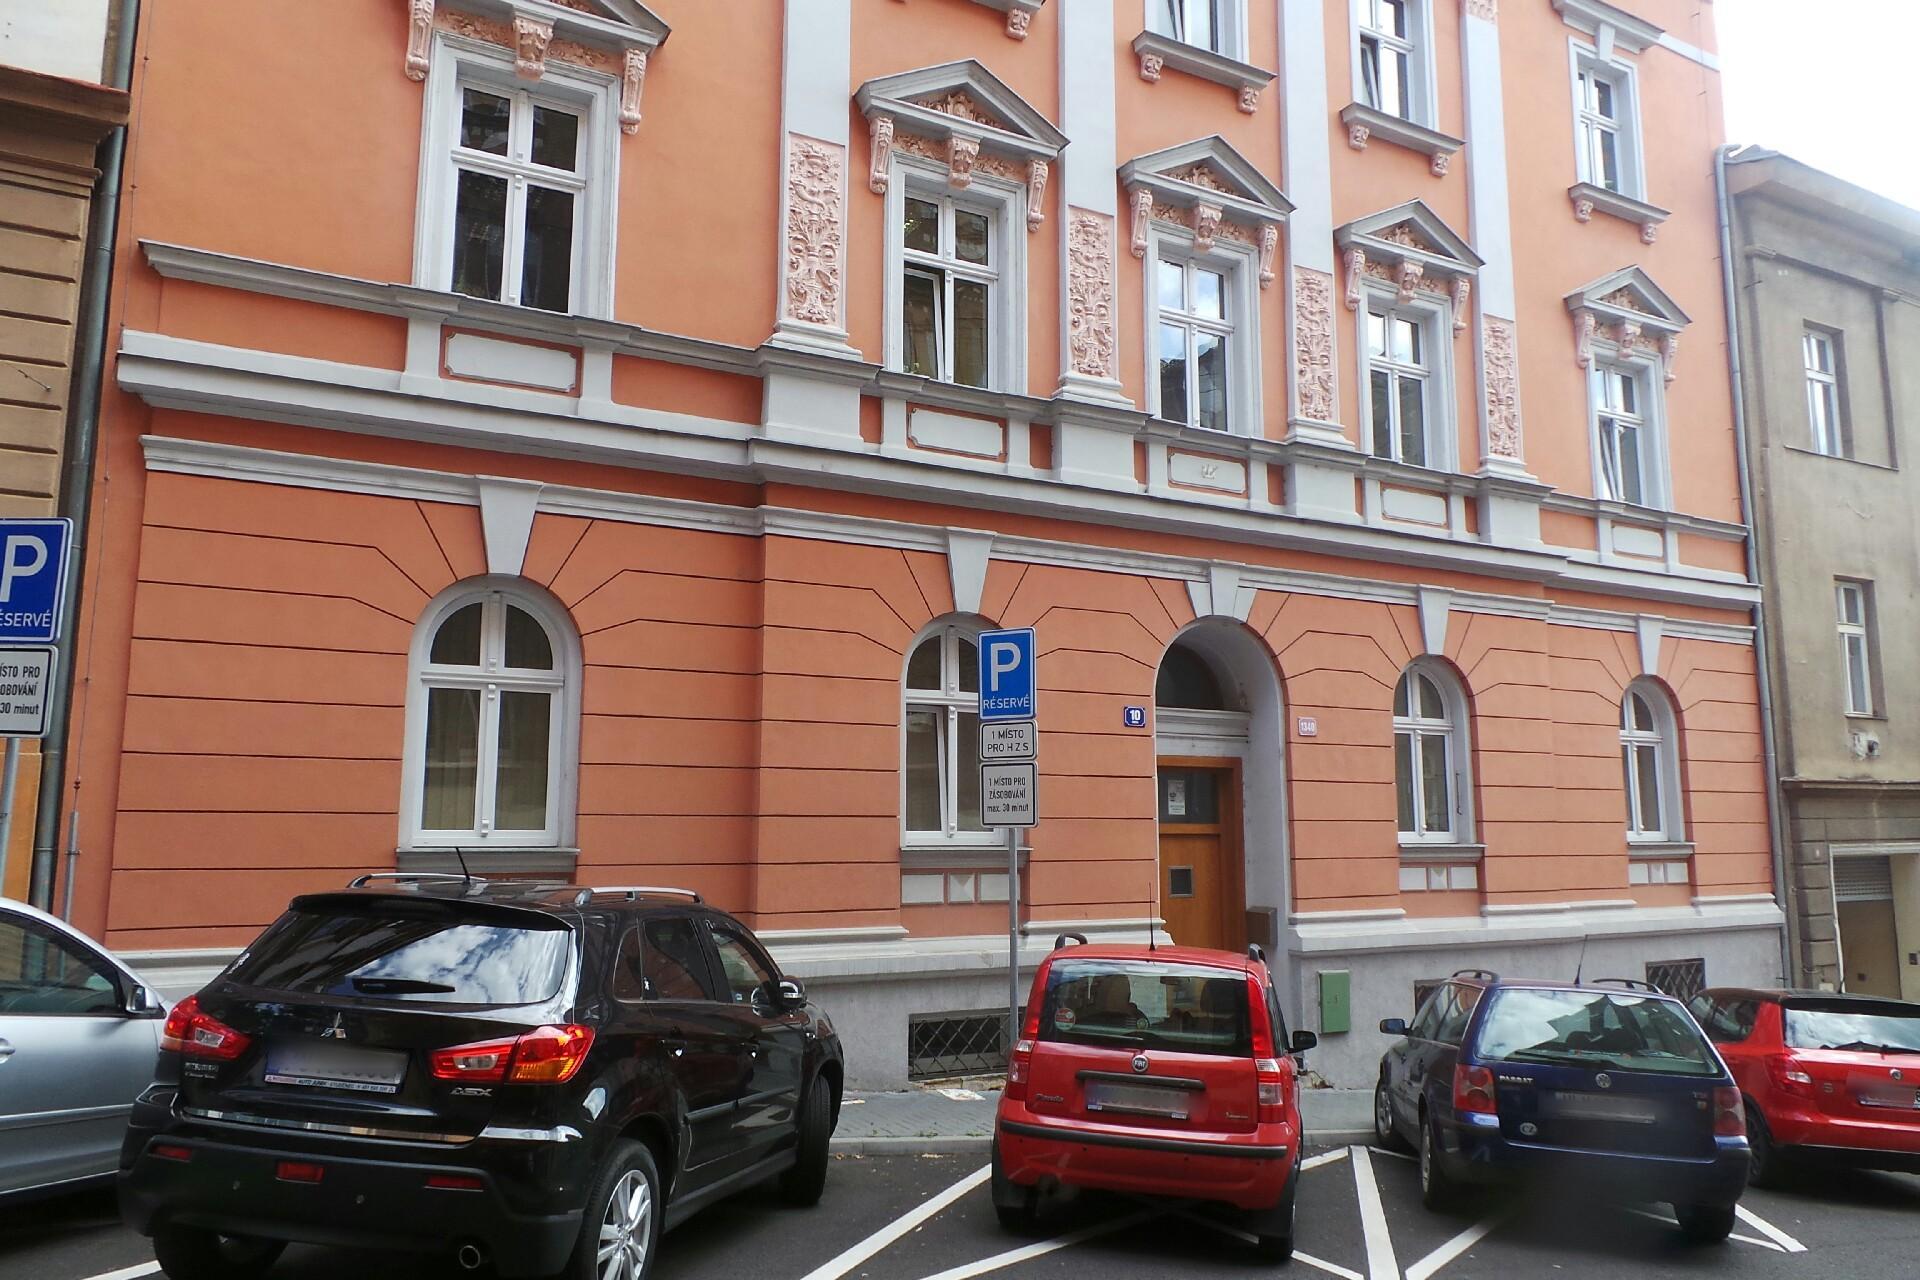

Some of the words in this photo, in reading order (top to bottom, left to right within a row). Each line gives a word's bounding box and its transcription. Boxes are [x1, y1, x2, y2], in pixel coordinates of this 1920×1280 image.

[0, 535, 48, 603] P
[22, 666, 40, 678] PRO
[990, 642, 1021, 692] P
[983, 693, 1030, 709] RÉSERVÉ
[13, 704, 39, 715] minut
[1129, 709, 1141, 721] 10
[991, 730, 995, 739] 1
[998, 728, 1024, 739] MÍSTO
[987, 743, 1005, 753] PRO
[1007, 743, 1013, 752] H
[1015, 742, 1021, 751] Z
[1022, 742, 1029, 751] S
[993, 776, 1012, 786] MÍSTO
[1013, 777, 1026, 786] PRO
[988, 788, 1026, 800] ZÁSOBOVÁNÍ
[986, 805, 1001, 813] max.
[1002, 803, 1010, 812] 30
[1011, 803, 1029, 812] minut
[1134, 1059, 1146, 1068] FIAT
[1499, 1074, 1534, 1084] PASSAT
[449, 1087, 493, 1097] ASX
